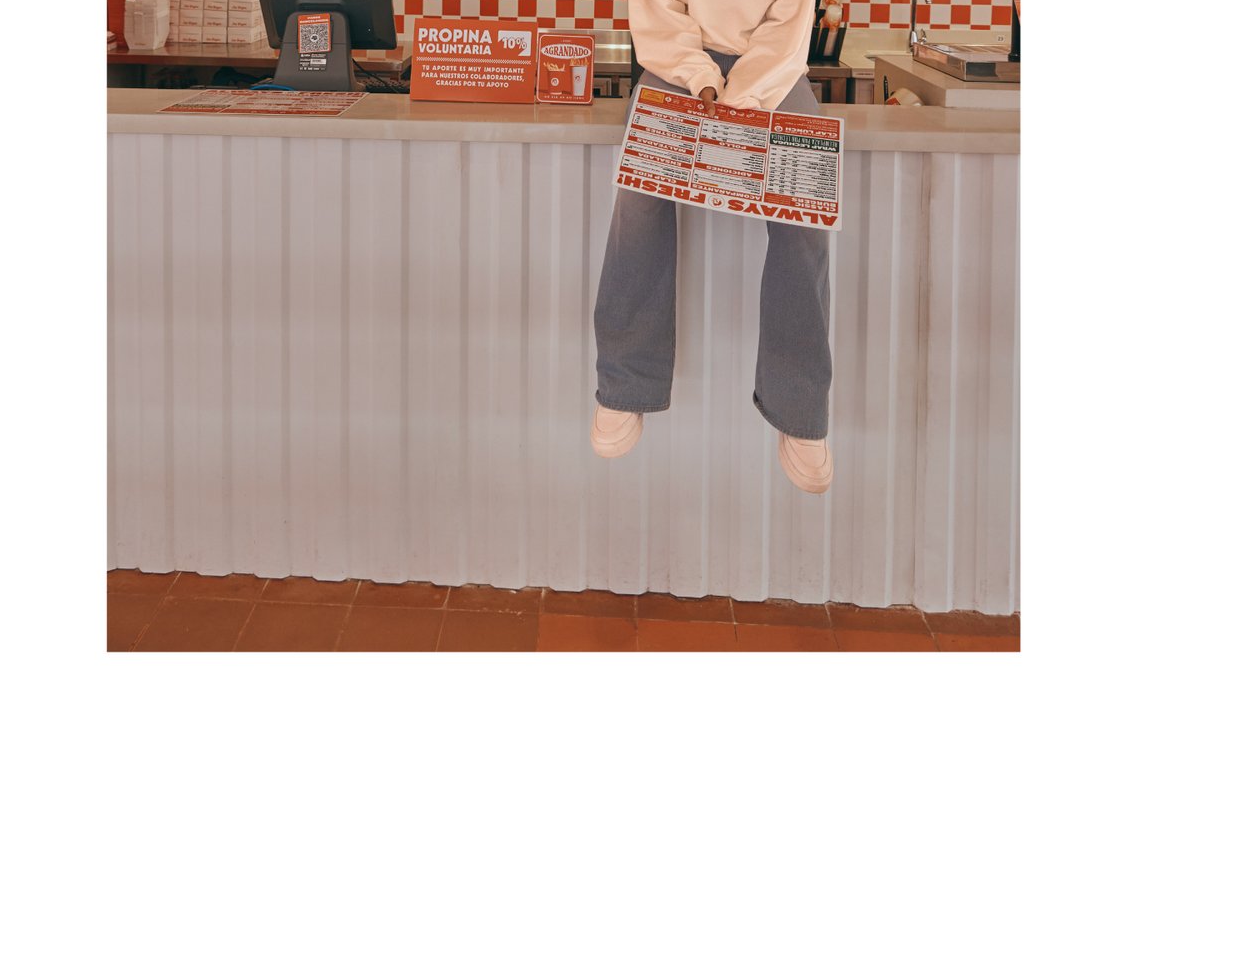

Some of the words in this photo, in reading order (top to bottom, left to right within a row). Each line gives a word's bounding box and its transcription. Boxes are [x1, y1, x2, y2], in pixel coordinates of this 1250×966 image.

[418, 28, 492, 43] PROPINA
[502, 37, 527, 50] 10%
[418, 43, 492, 55] VOLUNTARIA
[543, 45, 589, 58] AGRANDADO
[470, 74, 525, 82] COLABORADORES,
[636, 138, 686, 153] MALTEADAS
[638, 152, 682, 167] ENSALADA
[706, 165, 752, 177] ADICIONES
[617, 174, 706, 204] FRESH!
[791, 197, 836, 207] BURGERS
[794, 202, 836, 212] CLASSIC
[727, 199, 838, 226] ALWAYS
